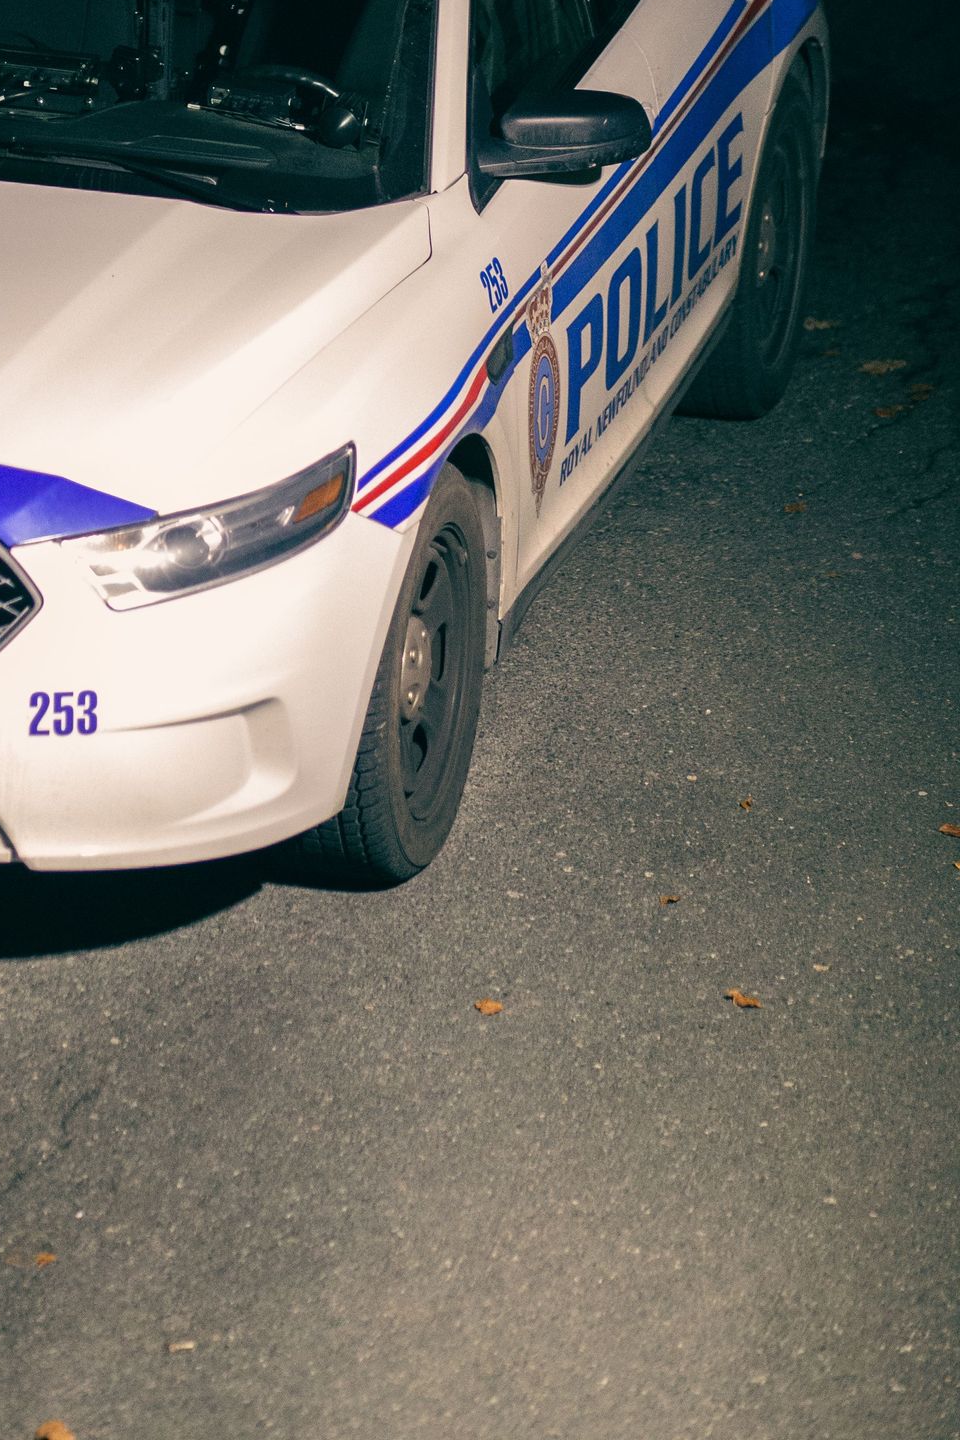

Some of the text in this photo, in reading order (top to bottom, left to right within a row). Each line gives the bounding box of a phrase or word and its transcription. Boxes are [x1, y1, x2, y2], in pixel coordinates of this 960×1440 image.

[480, 257, 509, 314] 253
[565, 111, 744, 447] POLICE
[559, 426, 592, 487] ROYAL
[595, 324, 669, 441] NEWFOUNDLAND
[28, 689, 98, 736] 253
